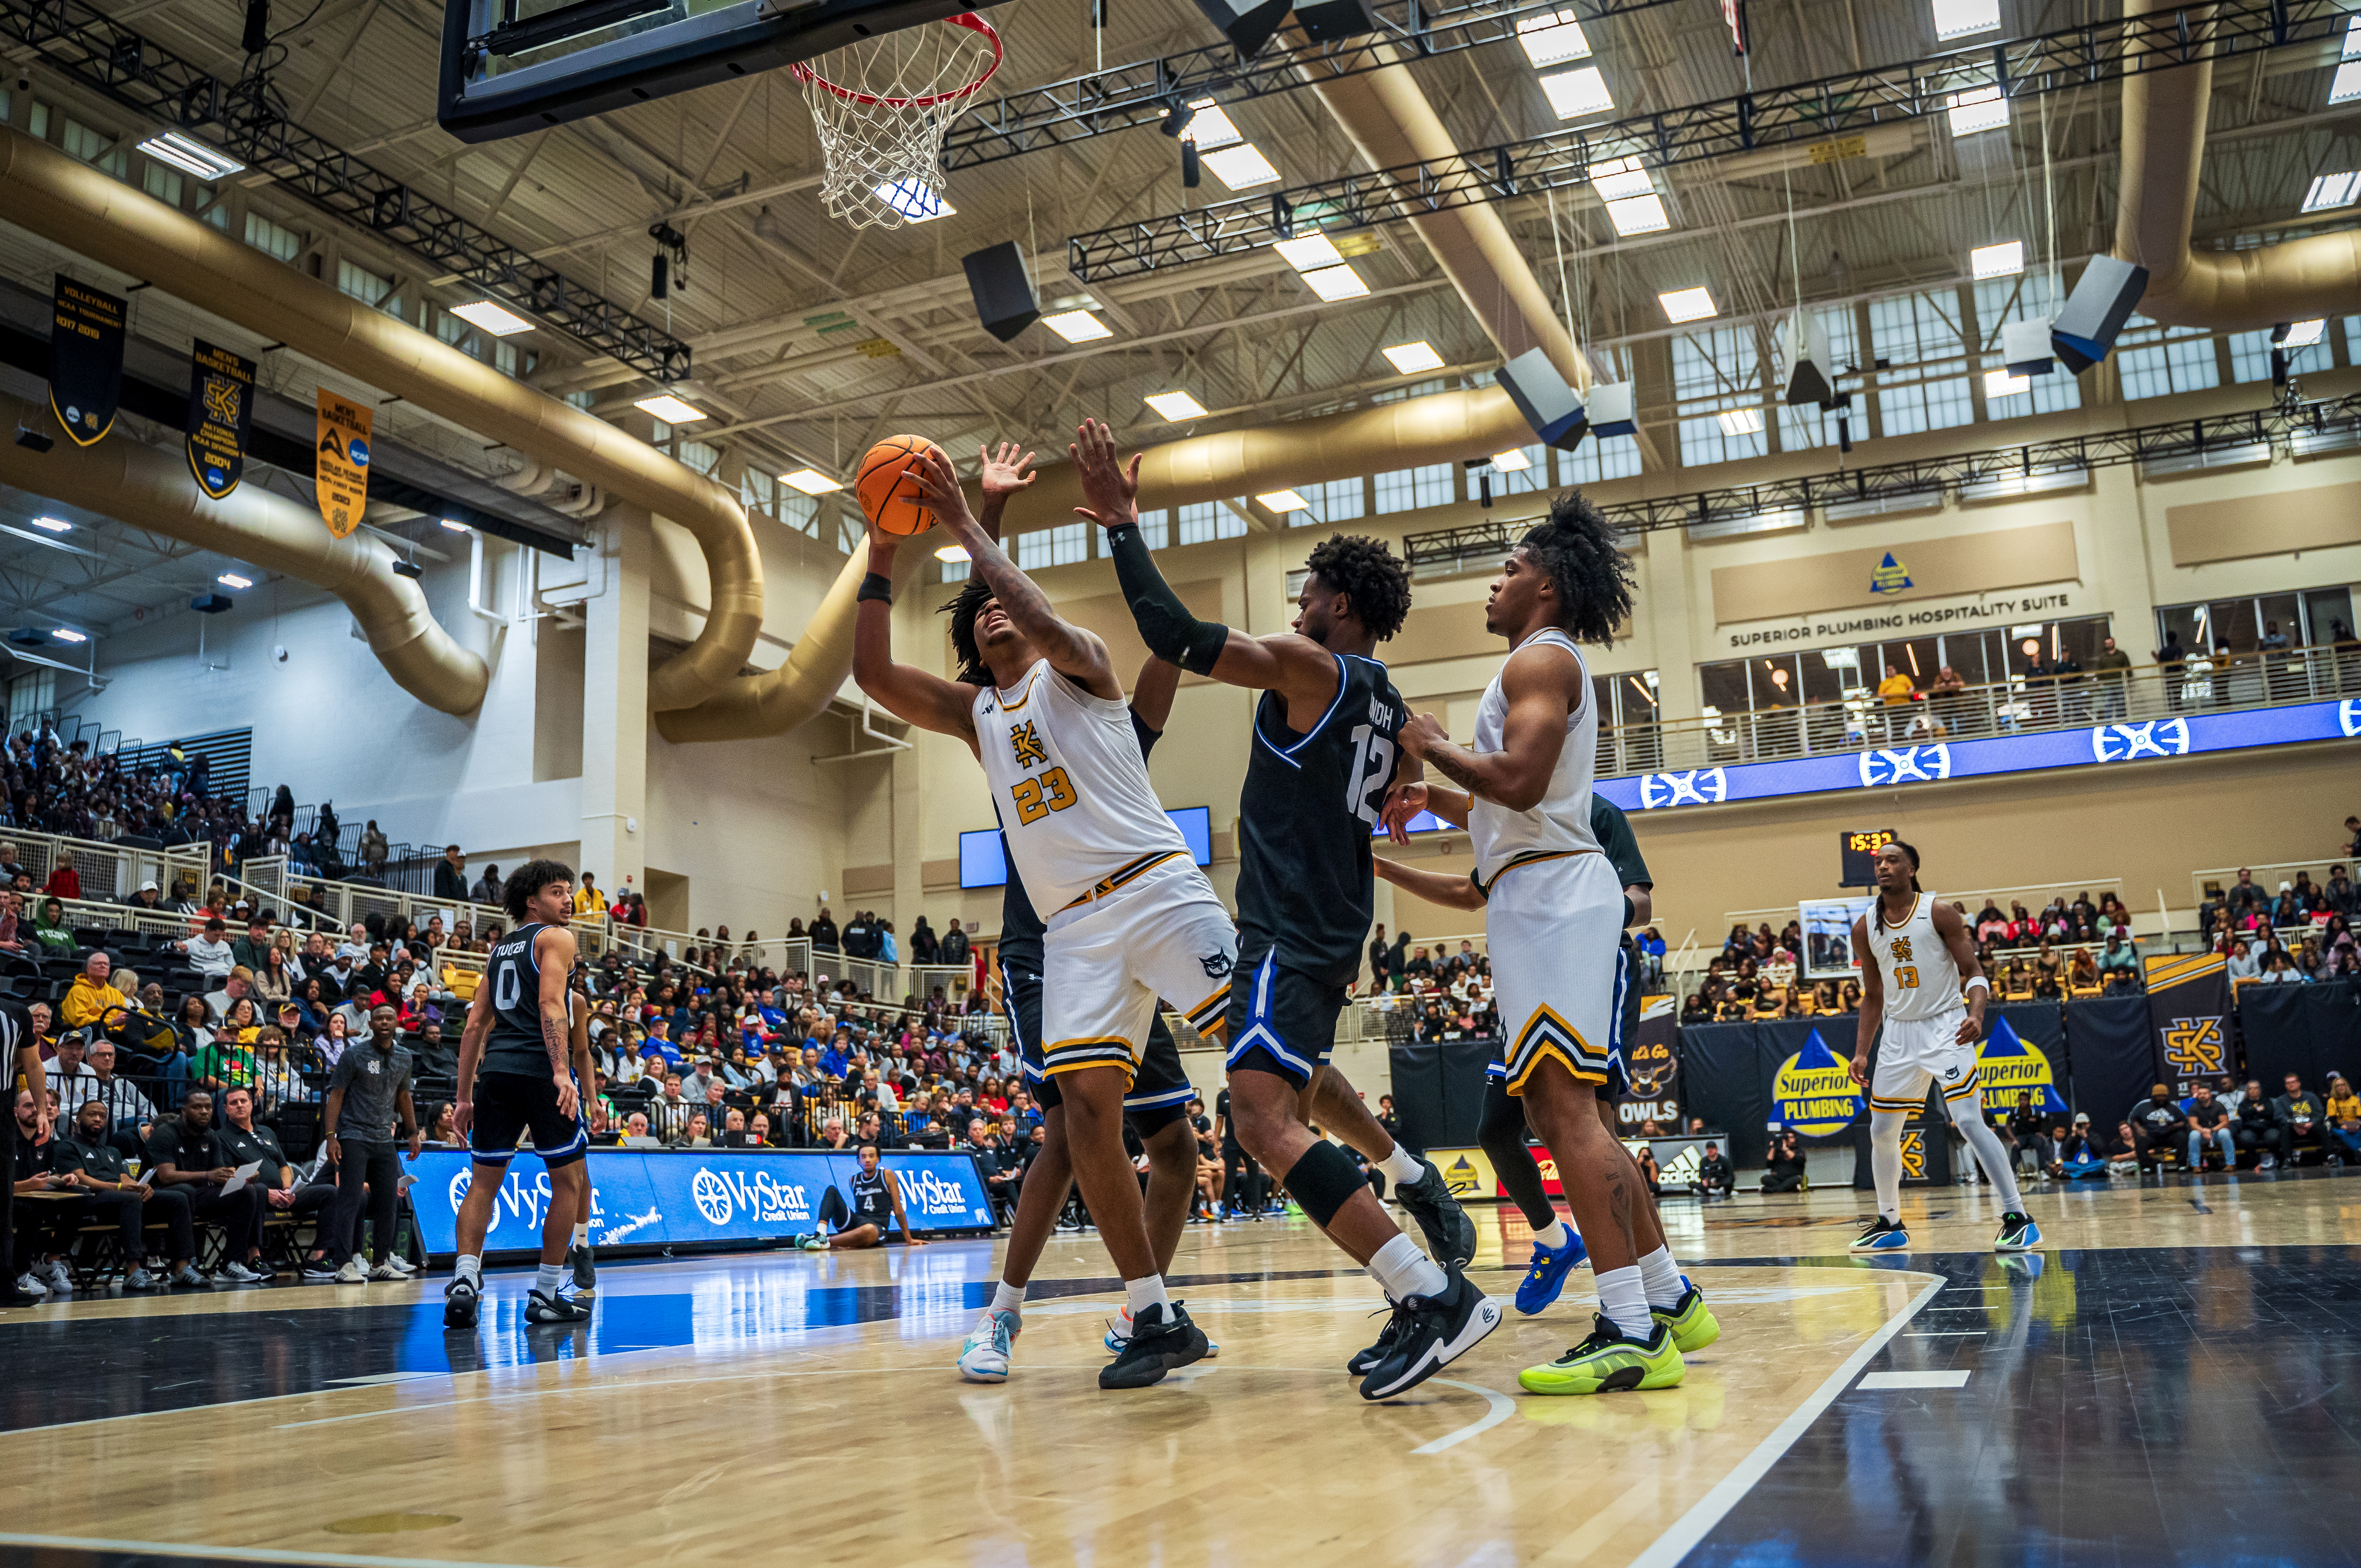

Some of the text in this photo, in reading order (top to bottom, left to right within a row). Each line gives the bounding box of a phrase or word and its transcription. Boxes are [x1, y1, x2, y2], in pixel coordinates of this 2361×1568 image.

[64, 285, 118, 315] VOLLEYBALL
[57, 299, 122, 329] NCAA TOURNAMENT
[195, 351, 252, 384] BASKETBALL
[212, 348, 239, 367] MEN'S
[322, 408, 367, 435] BASKETBALL
[205, 451, 230, 470] 2004
[1731, 594, 2069, 647] SUPERIOR PLUMBING HOSPITALITY SUITE
[1346, 724, 1394, 829] 12
[1010, 766, 1078, 827] 23
[495, 960, 521, 1010] 0
[1893, 966, 1920, 989] 13
[1651, 1043, 1669, 1059] Go
[1779, 1071, 1852, 1096] Superior
[1979, 1059, 2043, 1085] uperior
[1784, 1097, 1854, 1120] PLUMBING
[1981, 1086, 2045, 1109] LUMBG
[1619, 1100, 1678, 1123] OWLS
[1657, 1169, 1701, 1185] adid
[762, 1209, 810, 1222] Credit Union
[863, 1196, 875, 1212] 4
[929, 1203, 967, 1215] Credit Union
[588, 1218, 604, 1228] ion
